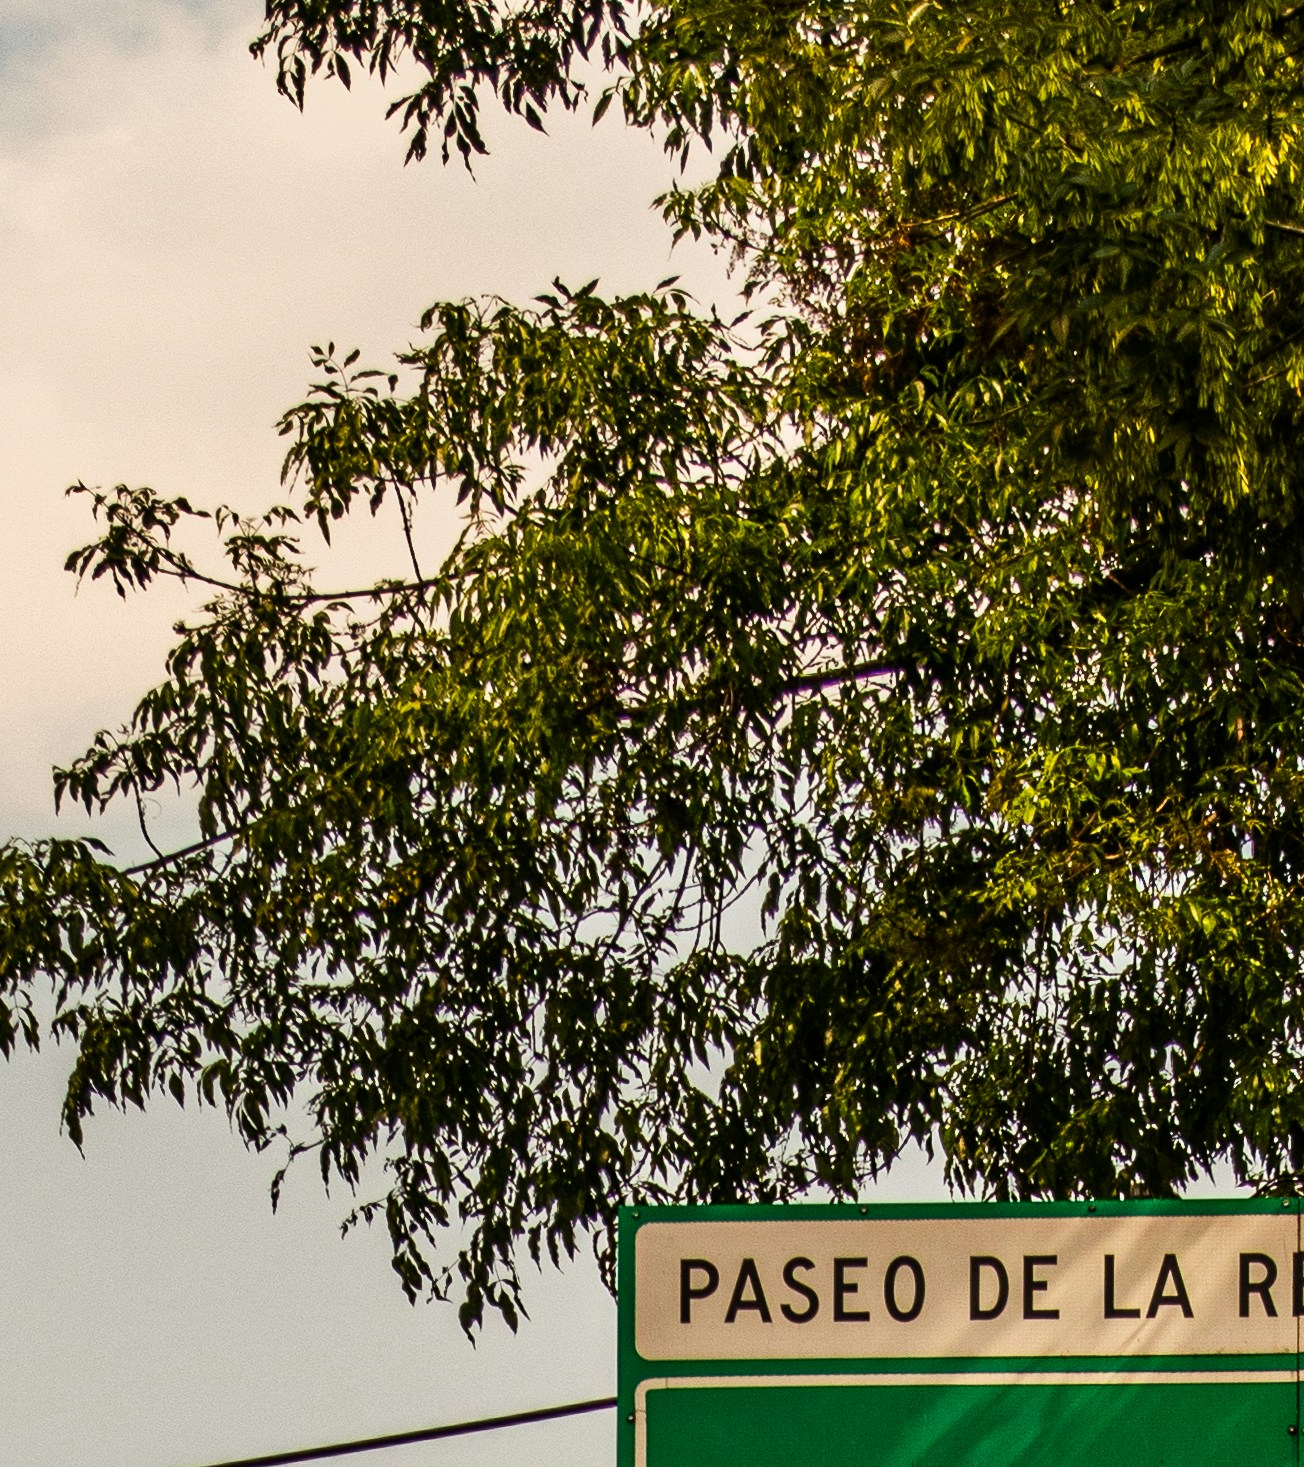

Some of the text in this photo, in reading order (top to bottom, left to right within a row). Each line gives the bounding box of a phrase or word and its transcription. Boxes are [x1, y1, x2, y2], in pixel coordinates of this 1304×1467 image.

[680, 1255, 926, 1323] PASEO
[969, 1255, 1060, 1321] DE
[1103, 1254, 1194, 1319] LA
